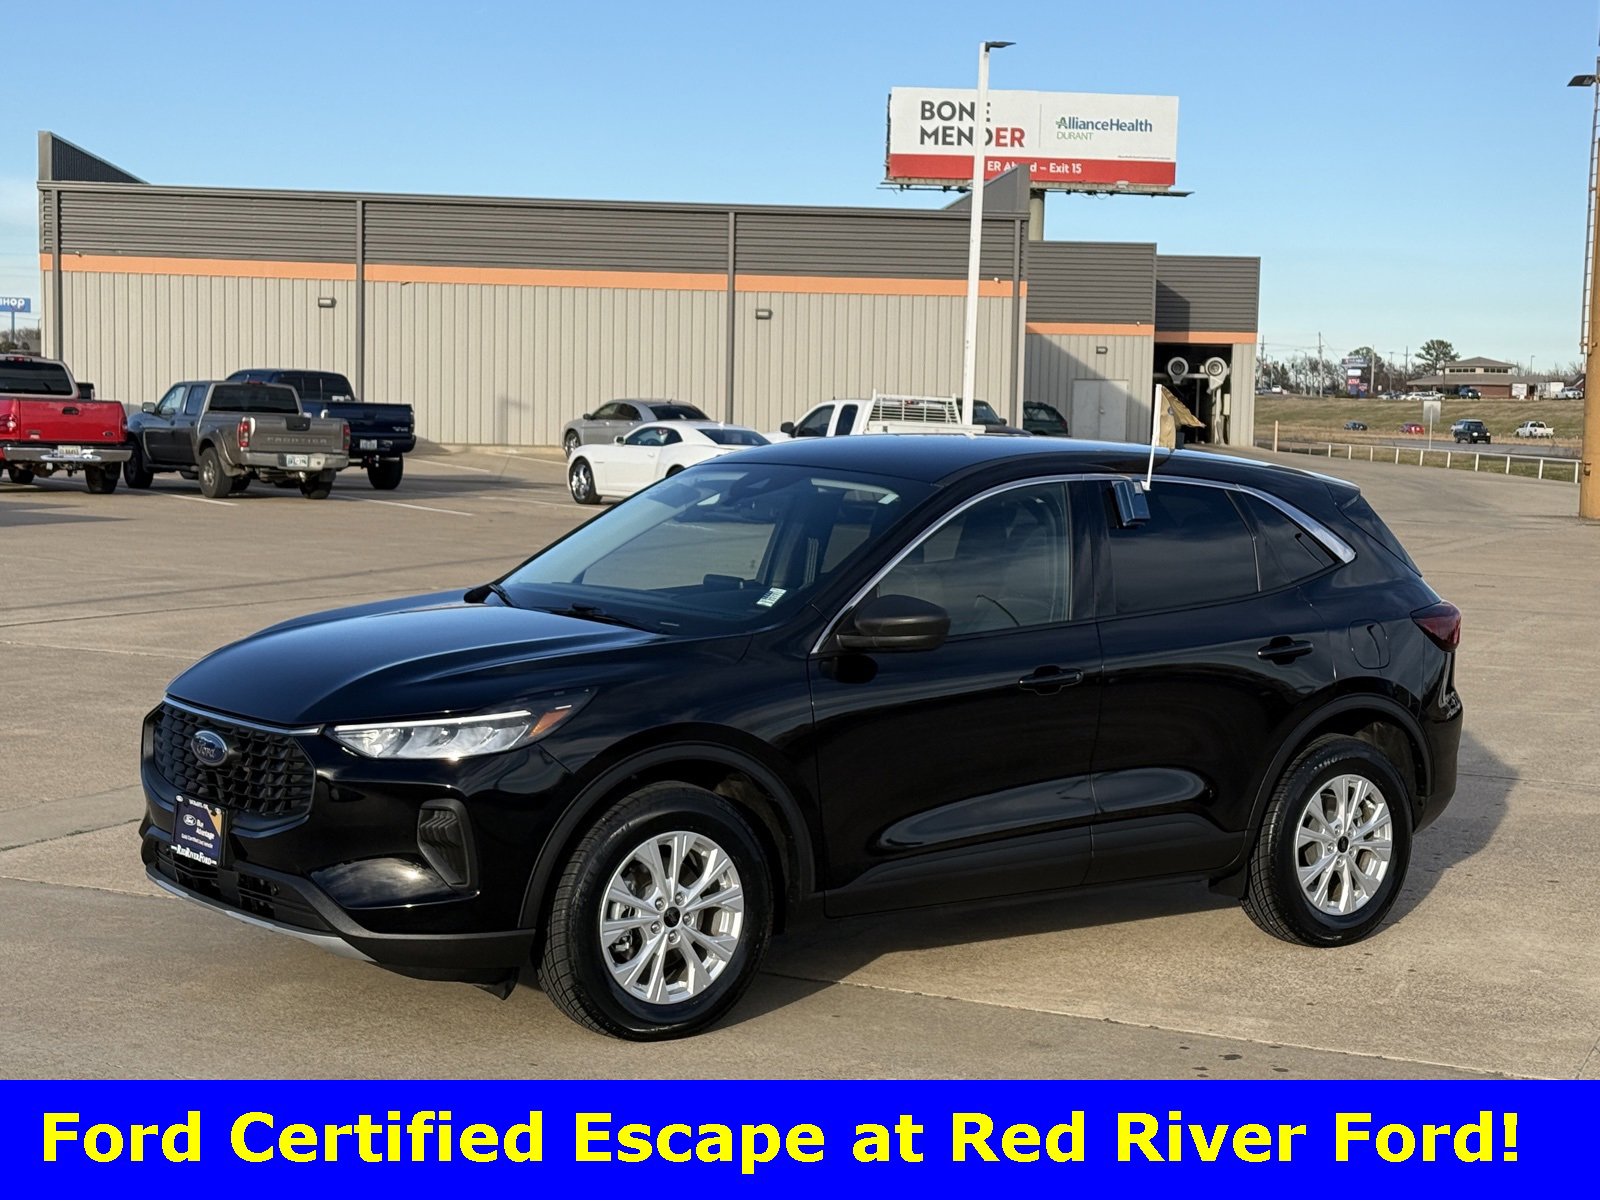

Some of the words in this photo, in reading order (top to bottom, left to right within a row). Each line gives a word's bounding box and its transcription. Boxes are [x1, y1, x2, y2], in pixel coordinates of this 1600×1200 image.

[920, 100, 991, 122] BON
[1056, 116, 1153, 132] AllianceHealth
[1056, 131, 1093, 140] DURANT
[987, 161, 1001, 171] ER
[1003, 161, 1037, 173] Ahd
[1049, 162, 1069, 173] Exit
[1072, 163, 1082, 174] 15
